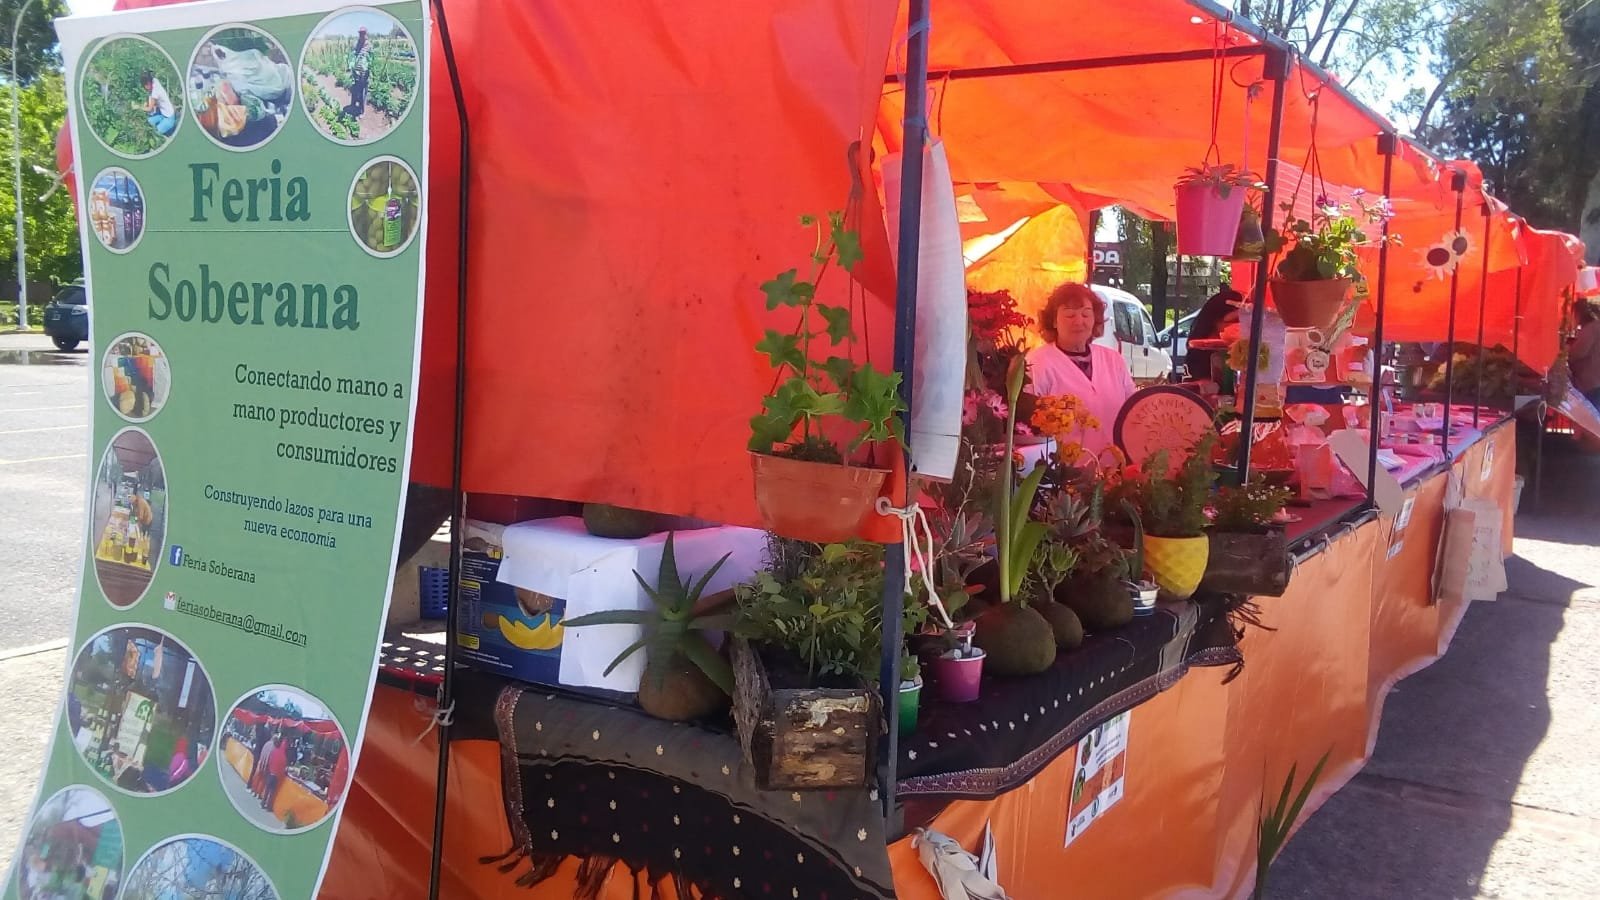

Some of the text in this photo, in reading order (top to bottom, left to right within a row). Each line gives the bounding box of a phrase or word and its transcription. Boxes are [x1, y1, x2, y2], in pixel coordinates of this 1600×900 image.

[188, 158, 311, 223] Feria
[148, 262, 360, 331] Soberana
[235, 363, 404, 399] Conectando mano a
[233, 402, 401, 442] mano productores y
[276, 442, 397, 473] consumidores
[204, 484, 372, 528] Construyendo lazos para una
[244, 519, 277, 537] nueva
[183, 553, 207, 572] Feria
[208, 560, 256, 584] Soberana
